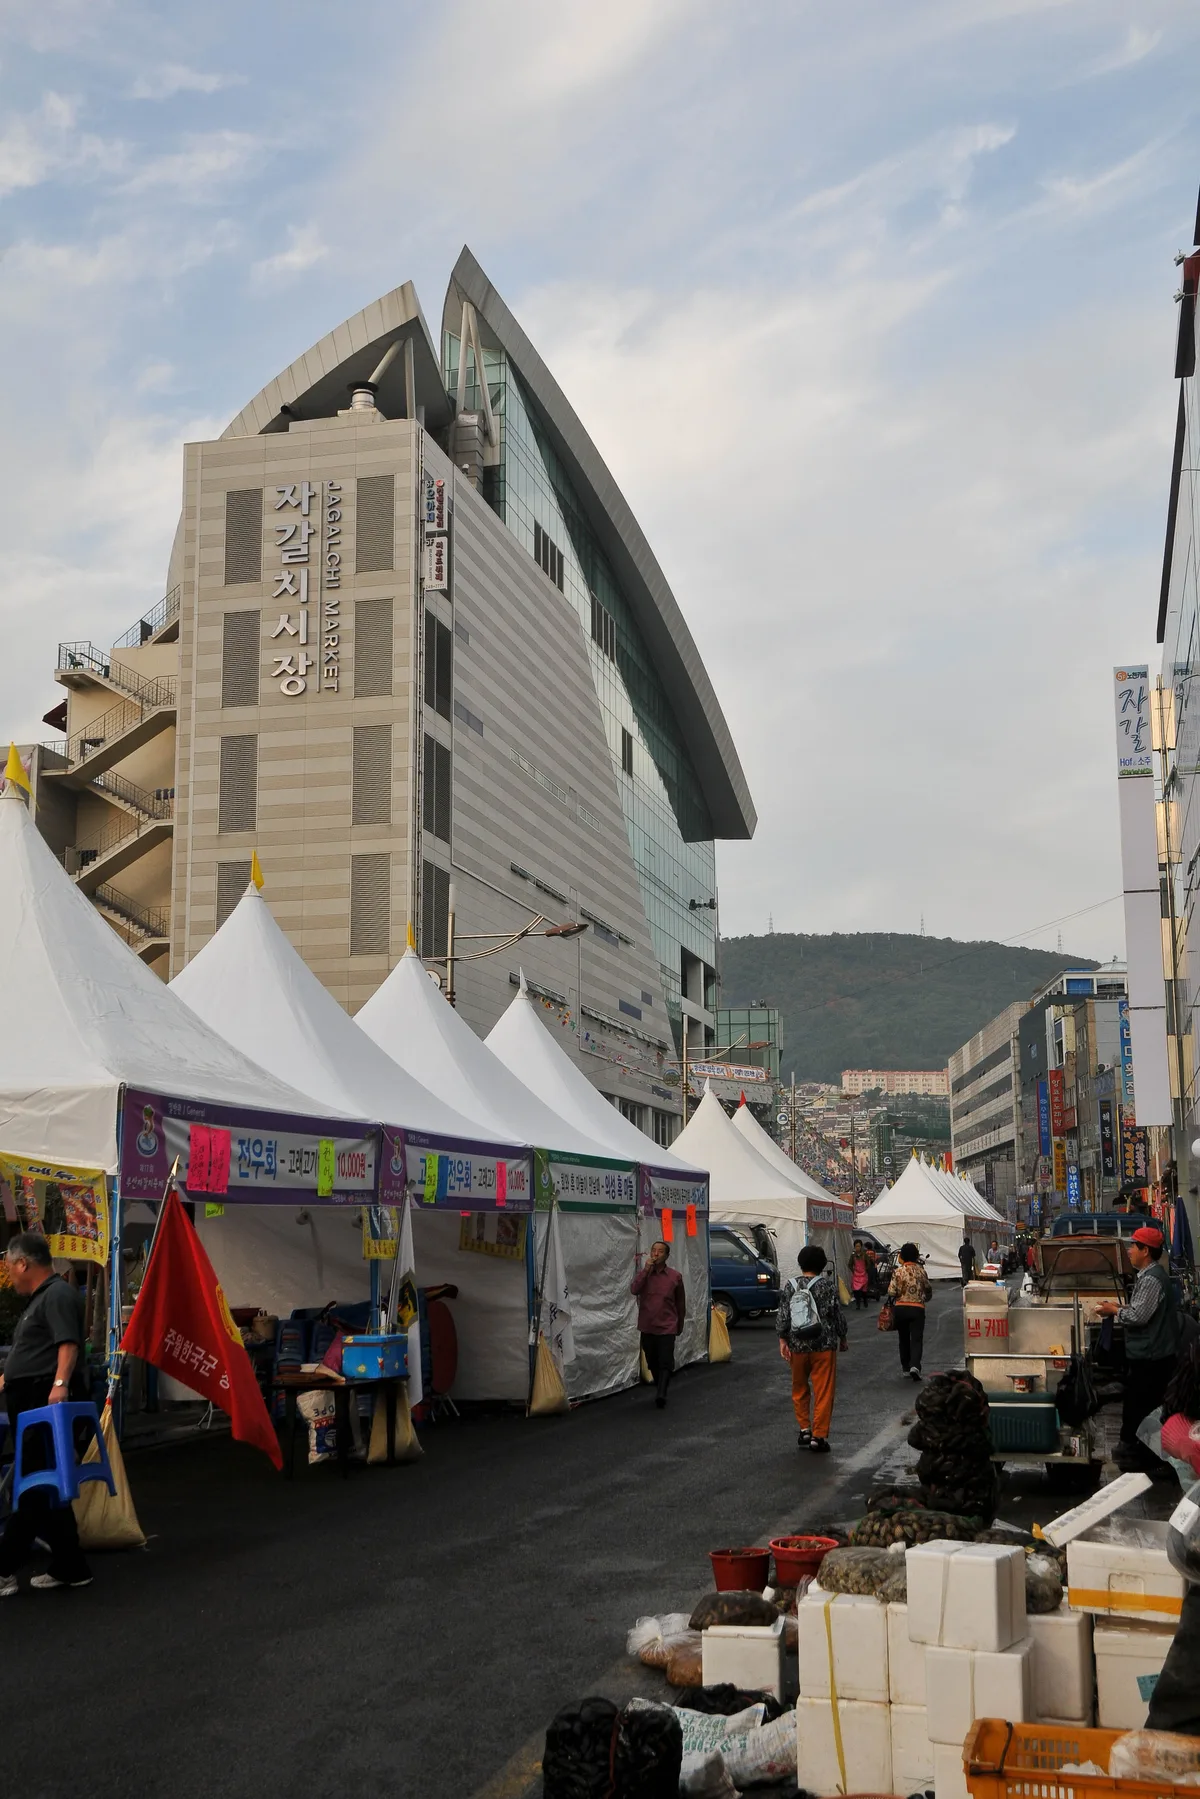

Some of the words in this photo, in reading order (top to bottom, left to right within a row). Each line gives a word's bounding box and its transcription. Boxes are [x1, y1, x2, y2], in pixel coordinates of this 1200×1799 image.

[326, 480, 342, 589] JAGALCHI
[270, 481, 316, 696] 자갈치시장
[324, 600, 340, 693] MARKET
[1119, 686, 1148, 753] 자갈
[1120, 758, 1132, 767] Hof
[1138, 756, 1151, 766] 소주
[337, 1152, 366, 1180] 10,000원
[605, 1174, 616, 1200] 의성
[624, 1176, 634, 1201] 마늘
[164, 1328, 219, 1377] 주월한국군
